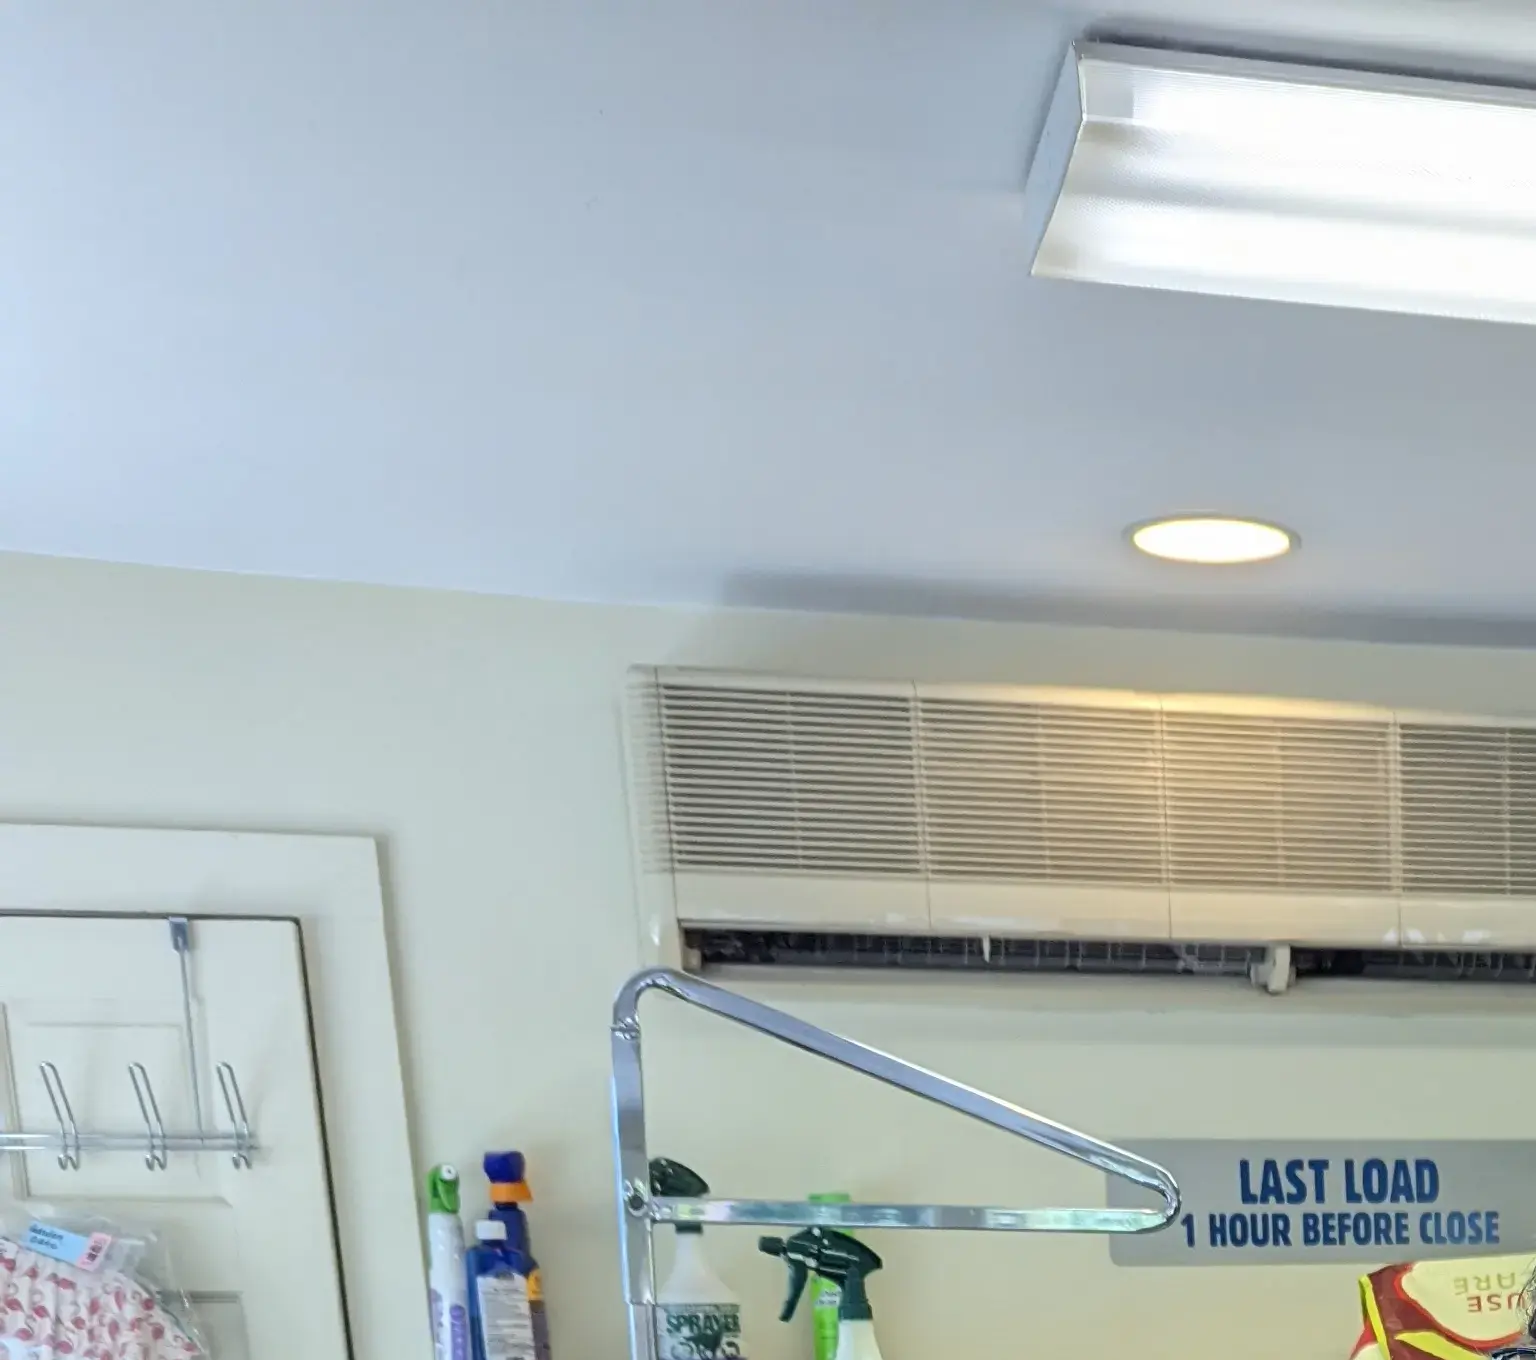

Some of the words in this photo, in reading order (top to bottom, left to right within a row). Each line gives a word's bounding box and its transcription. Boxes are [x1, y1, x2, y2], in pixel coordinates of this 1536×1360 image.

[1239, 1158, 1330, 1205] LAST
[1344, 1158, 1440, 1205] LOAD
[1180, 1215, 1196, 1248] 1
[1209, 1213, 1292, 1248] HOUR
[1303, 1211, 1411, 1247] BEFORE
[1419, 1209, 1501, 1245] CLOSE
[1453, 1272, 1522, 1296] ARE
